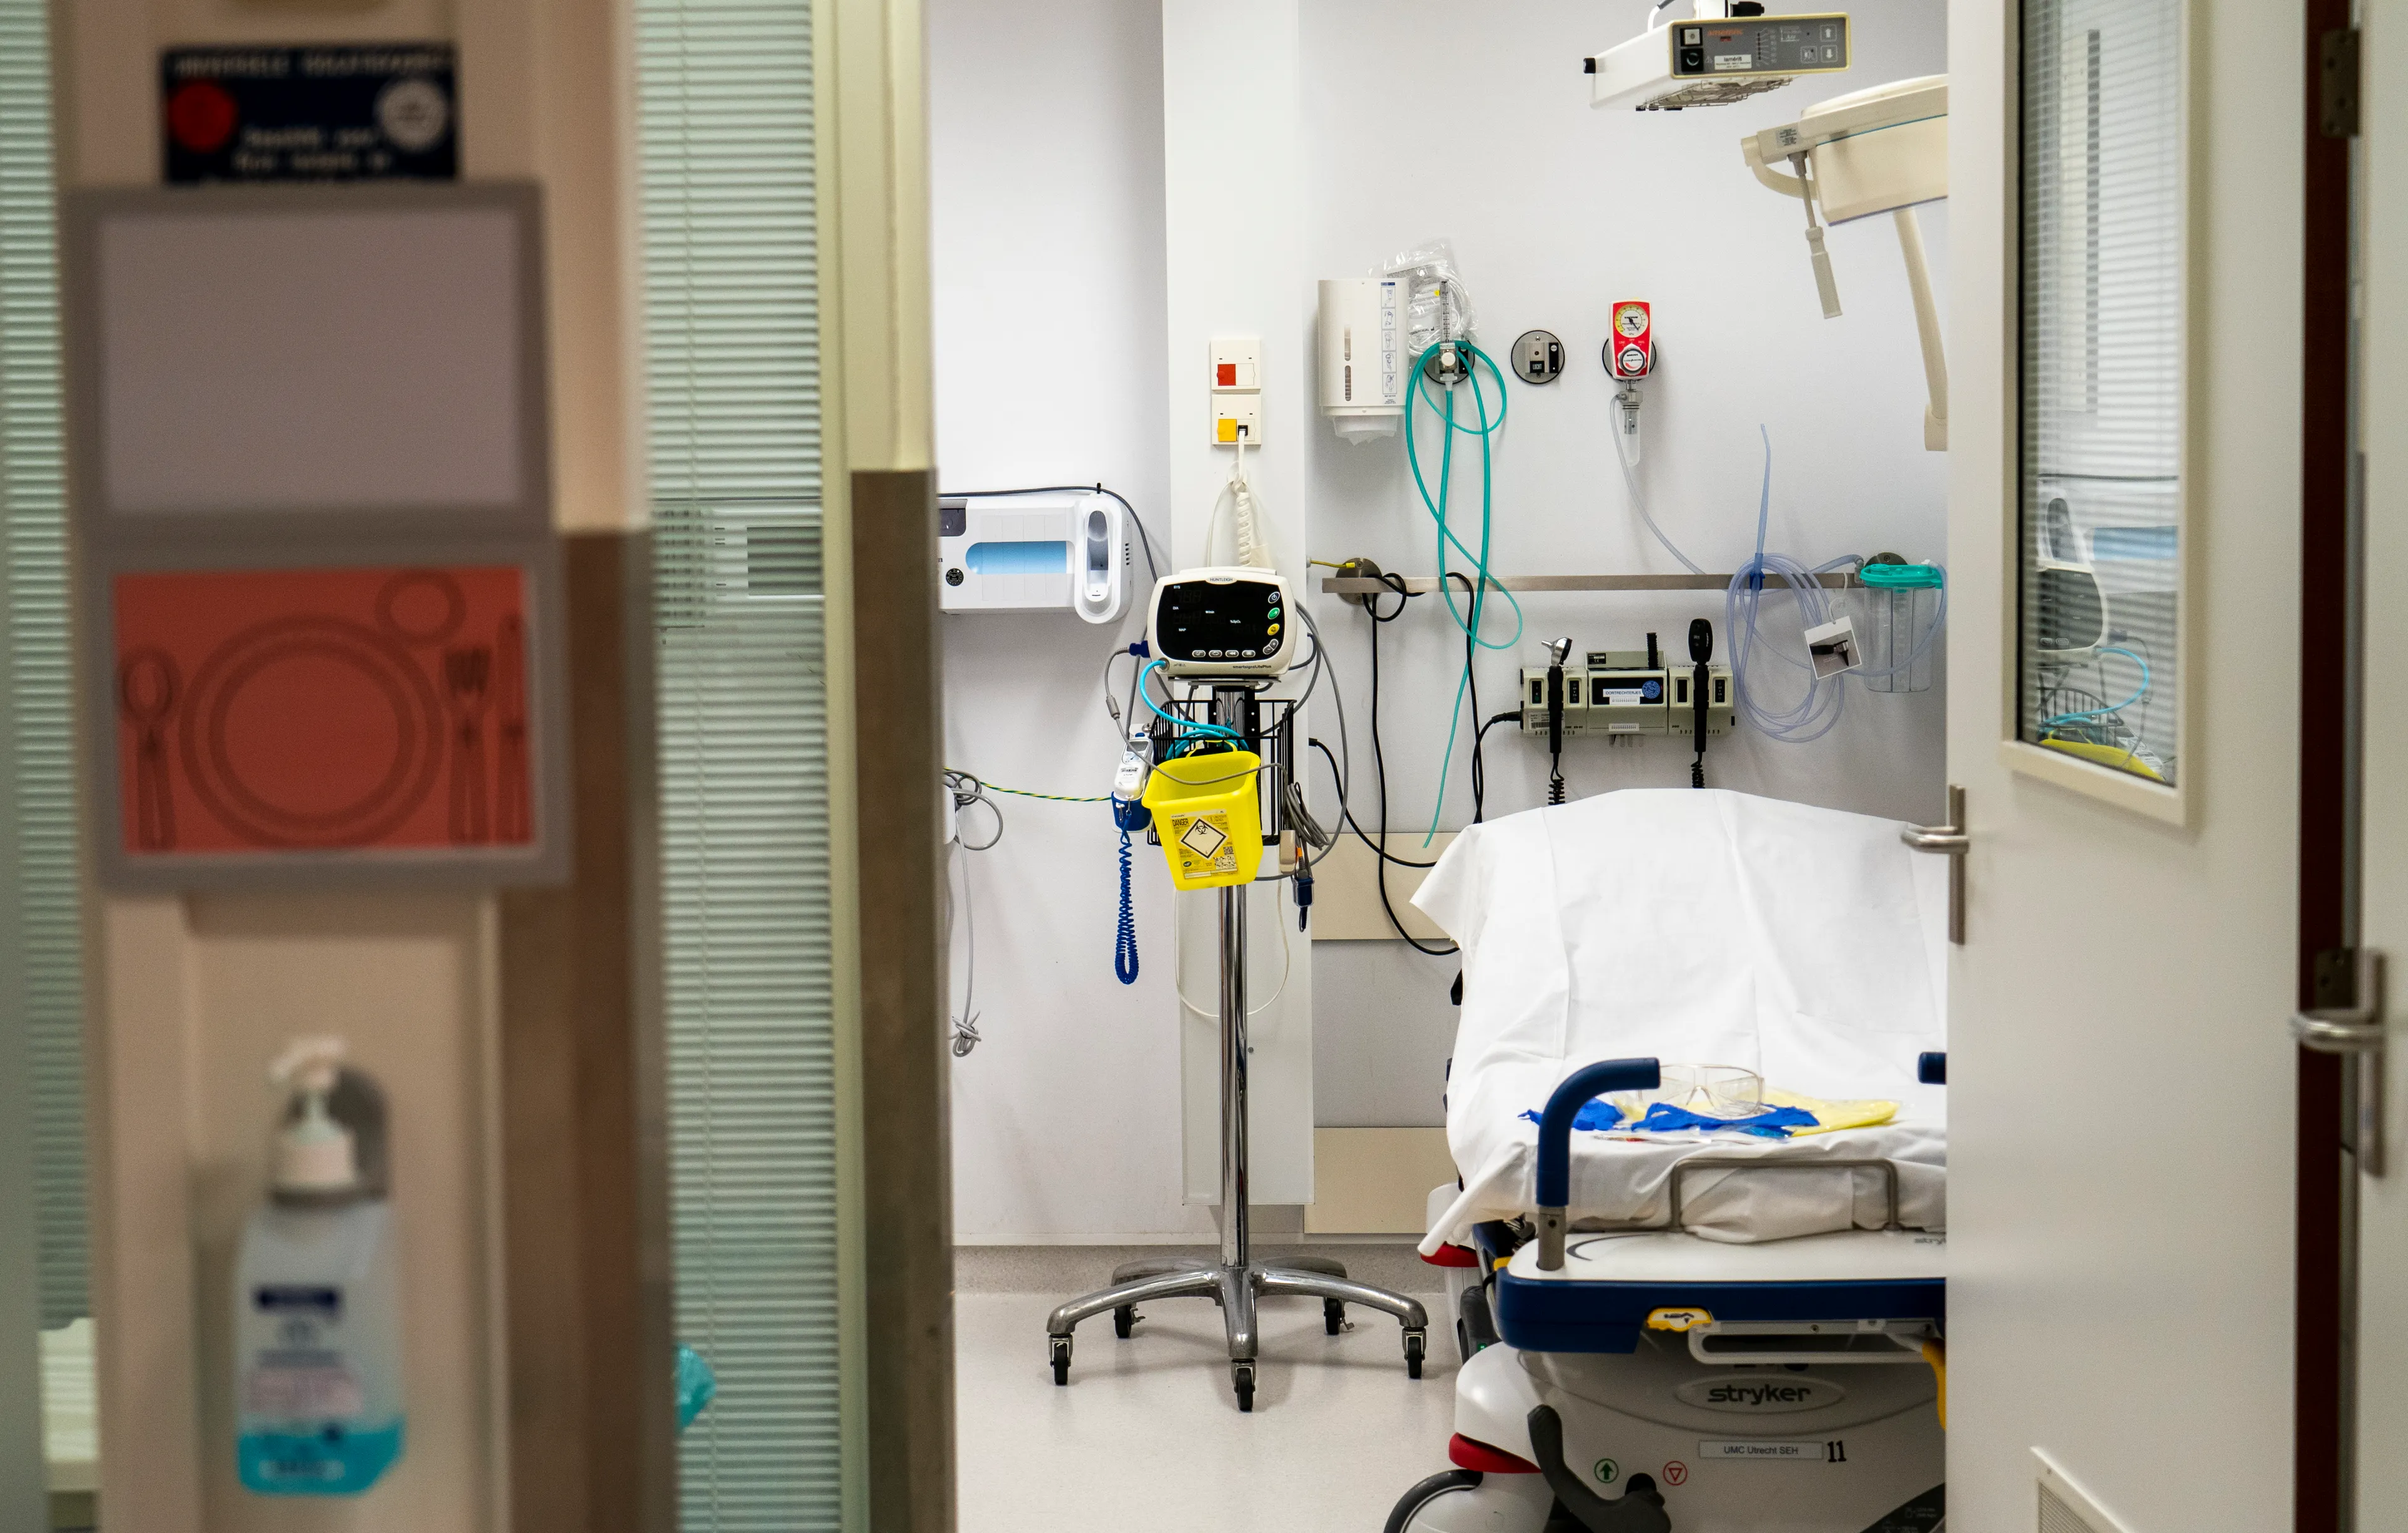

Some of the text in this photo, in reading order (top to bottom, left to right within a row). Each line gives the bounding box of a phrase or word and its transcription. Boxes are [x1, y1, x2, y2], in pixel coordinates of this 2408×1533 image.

[1172, 818, 1189, 826] DANGER
[1708, 1384, 1811, 1405] stryker
[1724, 1446, 1745, 1455] UMC
[1747, 1446, 1777, 1455] Utrecht
[1827, 1440, 1847, 1463] 11
